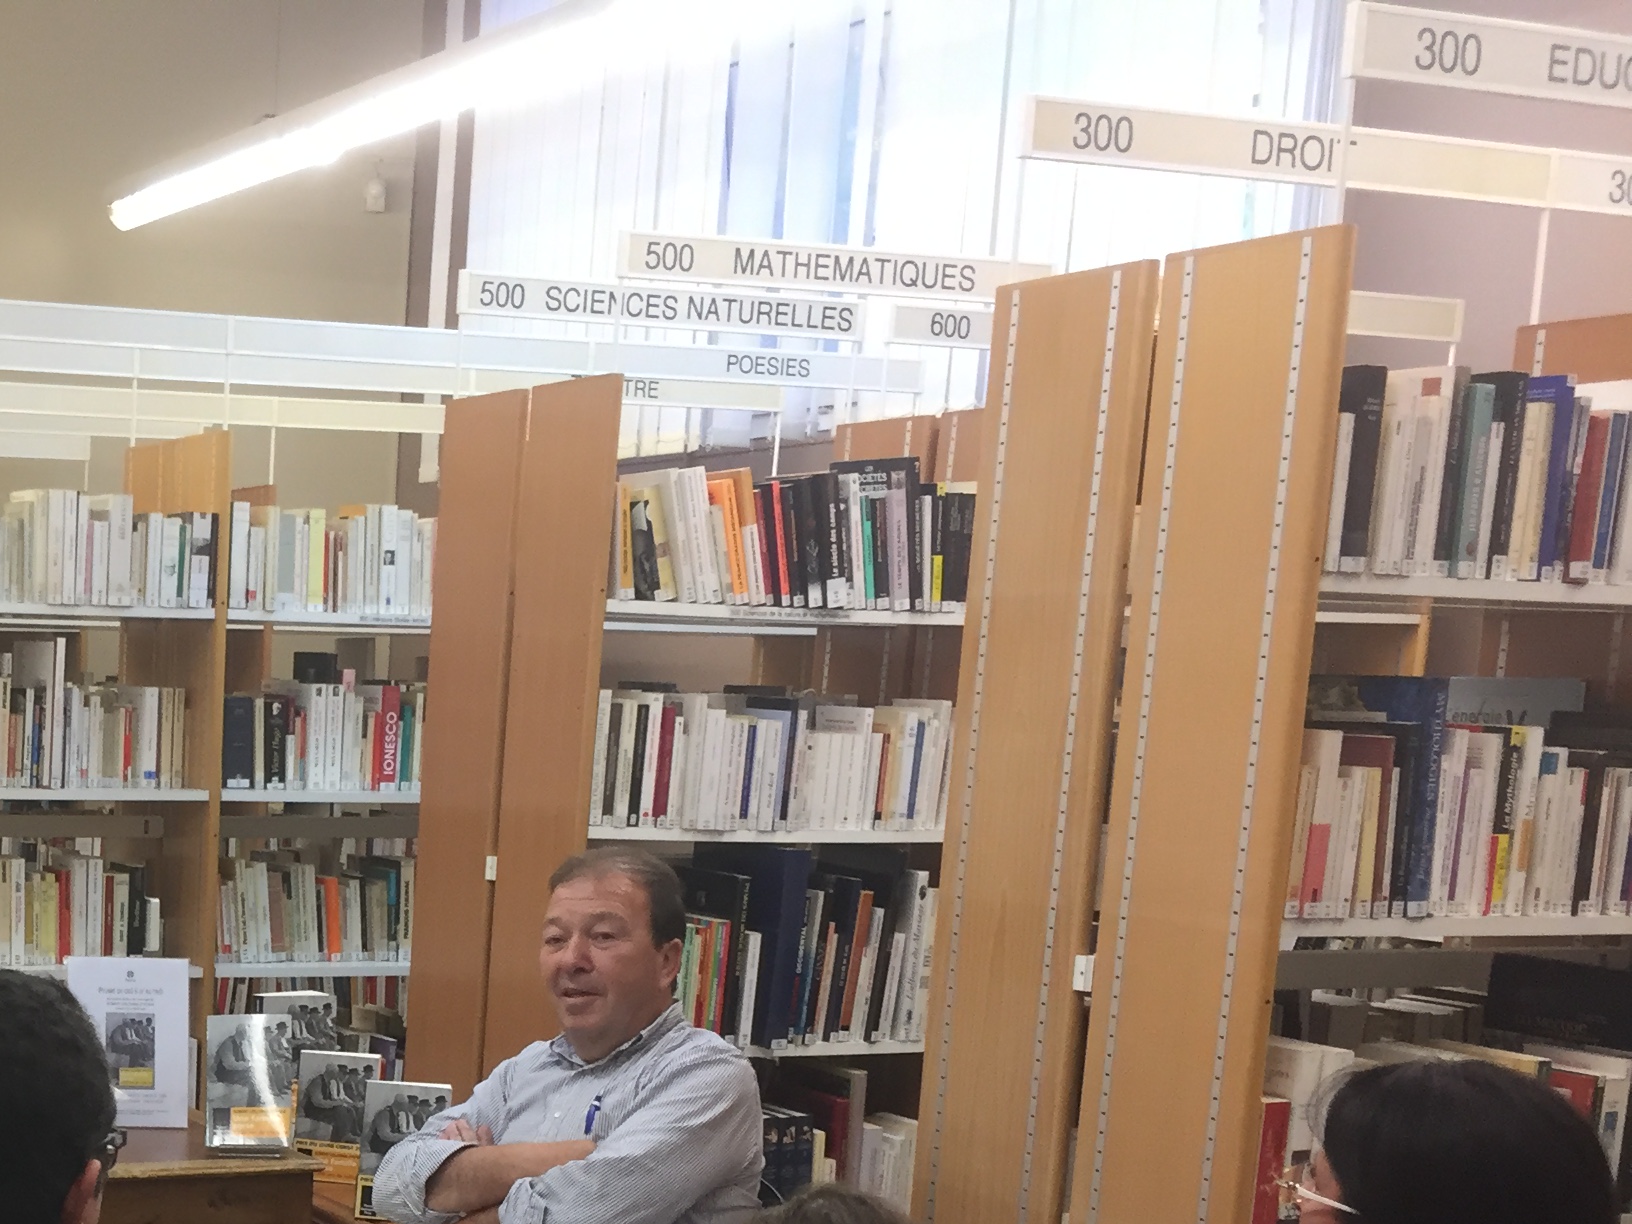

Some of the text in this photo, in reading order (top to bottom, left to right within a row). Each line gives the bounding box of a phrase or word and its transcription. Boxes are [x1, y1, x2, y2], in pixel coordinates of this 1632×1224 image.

[1414, 27, 1483, 77] 300
[1072, 112, 1134, 153] 300
[644, 241, 977, 293] 500 MATHEMATIQUES
[479, 280, 854, 333] 500 SCIENCES NATURELLES
[930, 313, 972, 341] 600
[726, 353, 812, 379] POESIES
[383, 711, 398, 775] IONESCO
[1426, 691, 1446, 802] MYTHOLOGIES
[1503, 751, 1519, 815] Mythologie
